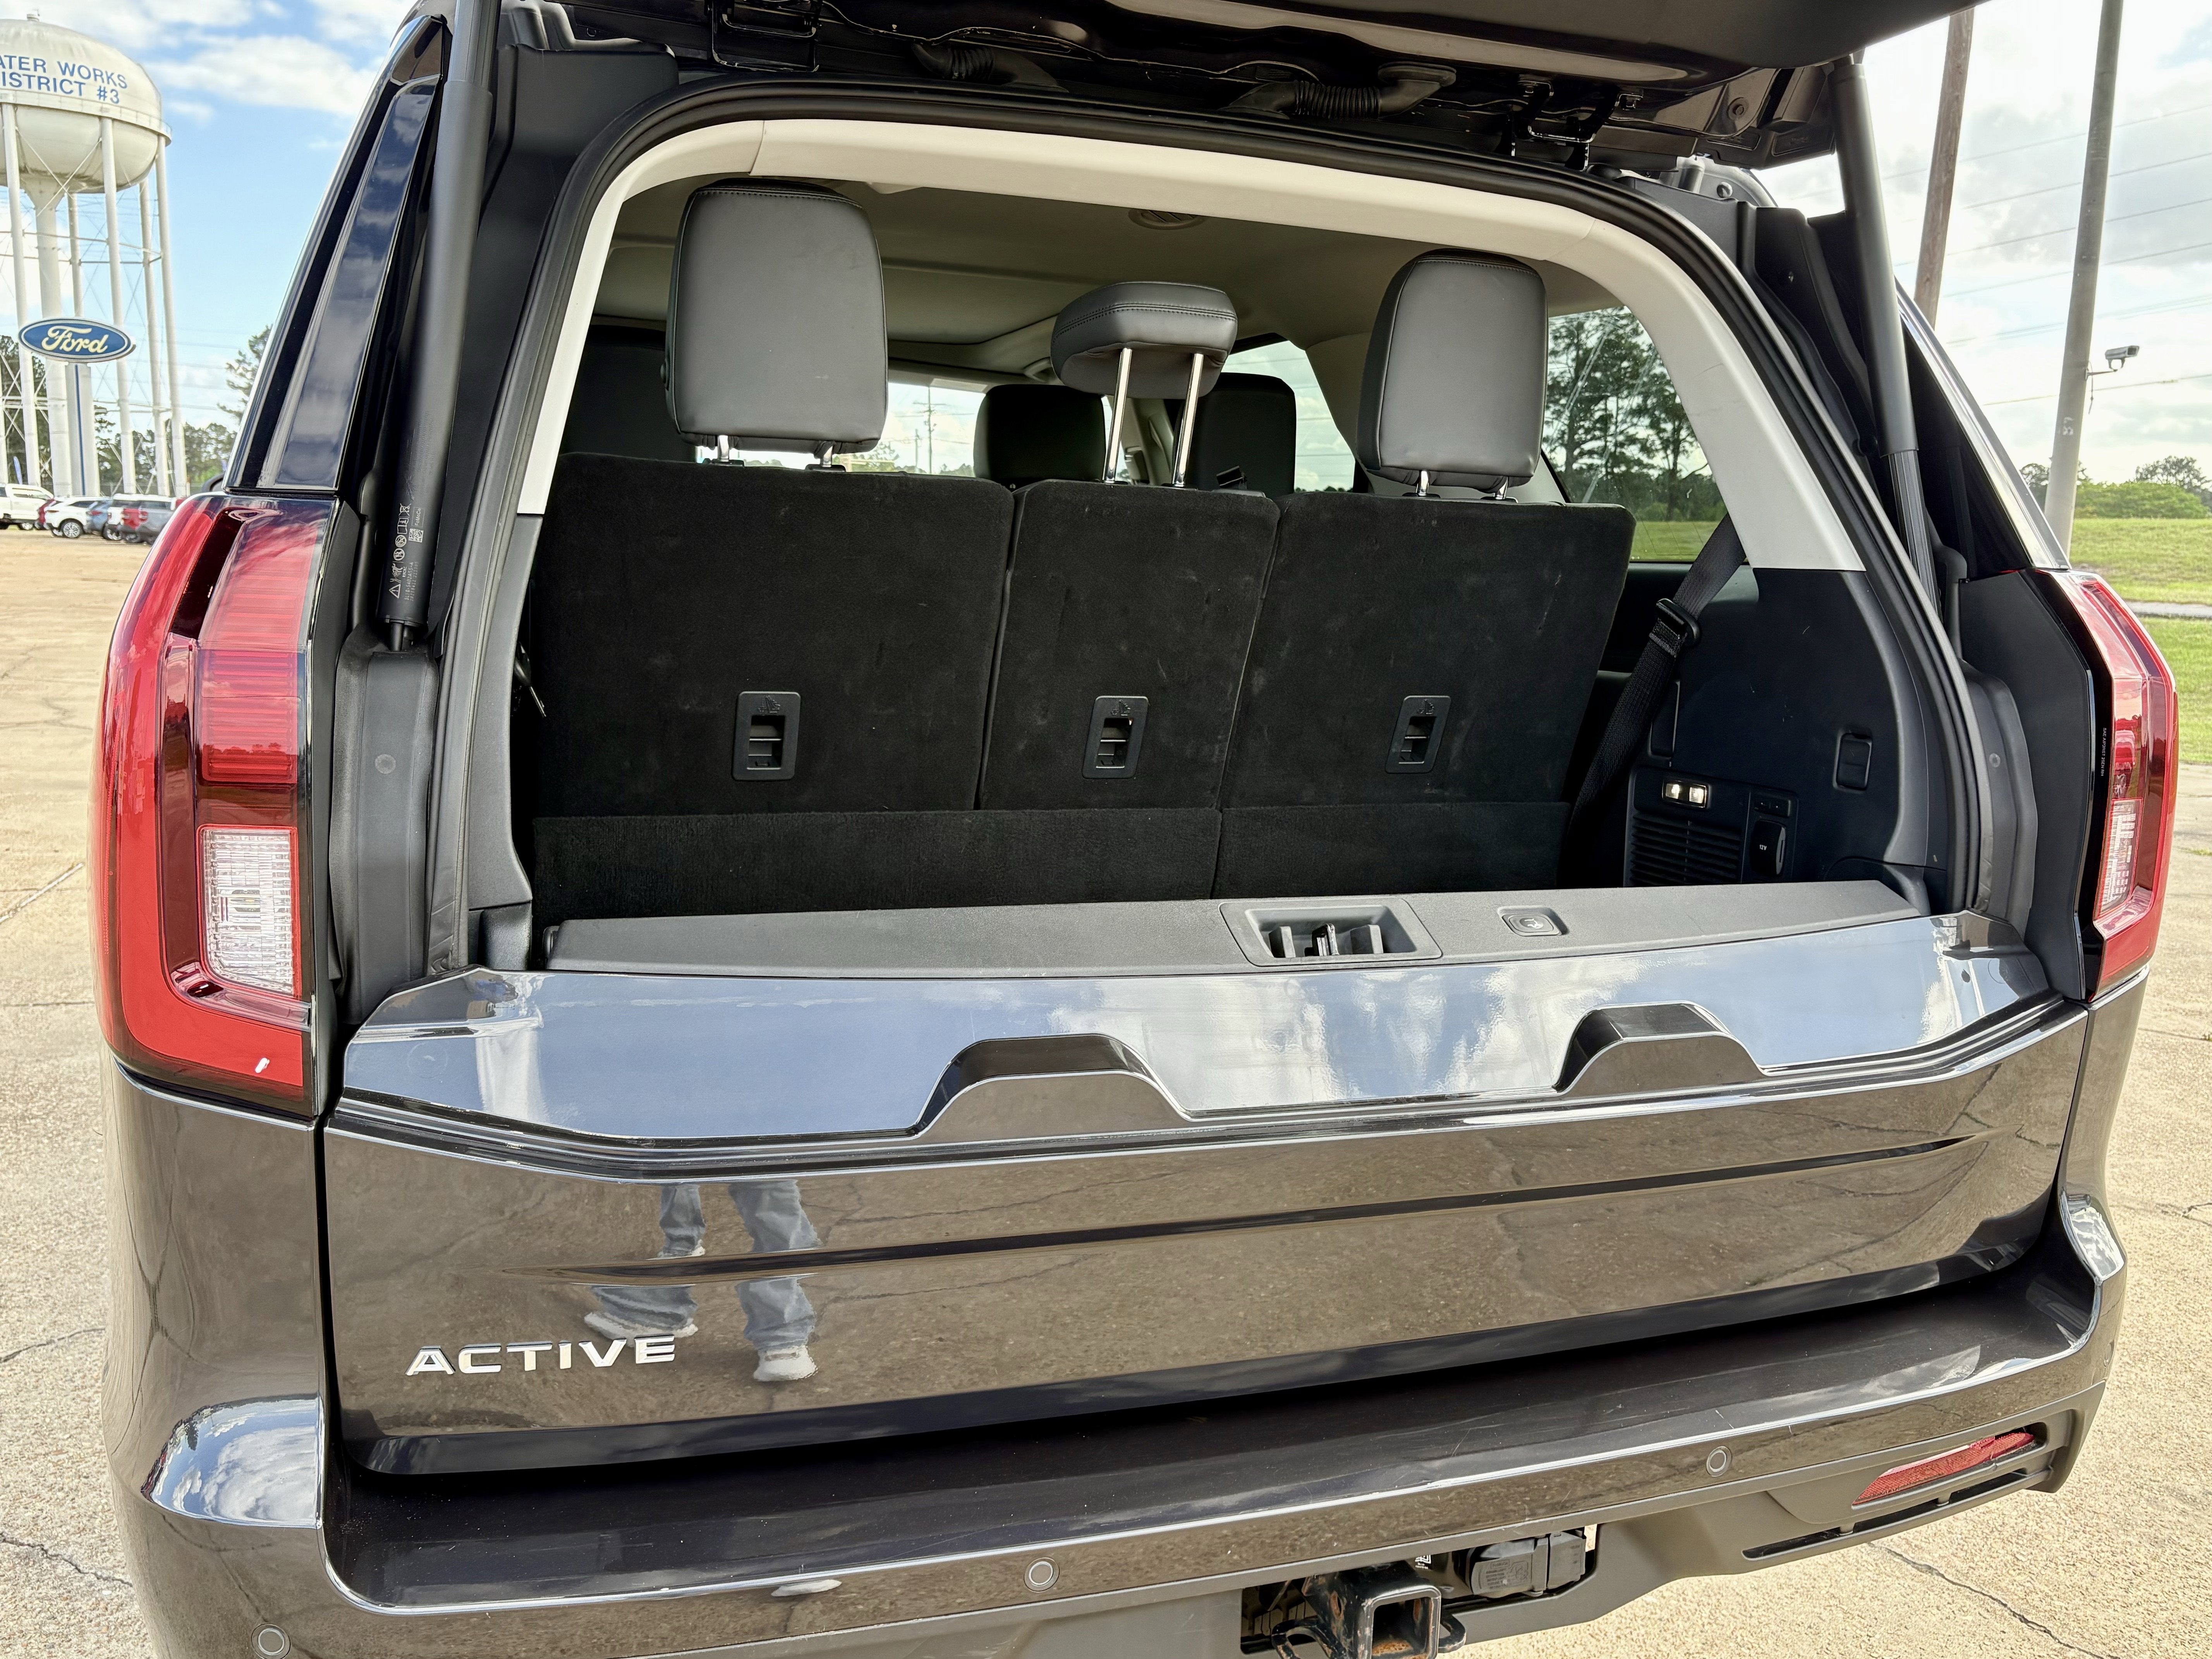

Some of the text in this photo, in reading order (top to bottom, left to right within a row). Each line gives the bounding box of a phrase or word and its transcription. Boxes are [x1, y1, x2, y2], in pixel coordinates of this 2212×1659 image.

[57, 61, 127, 89] WORKS
[97, 85, 120, 104] #3
[41, 325, 109, 353] Ford
[405, 1334, 676, 1376] ACTIVE
